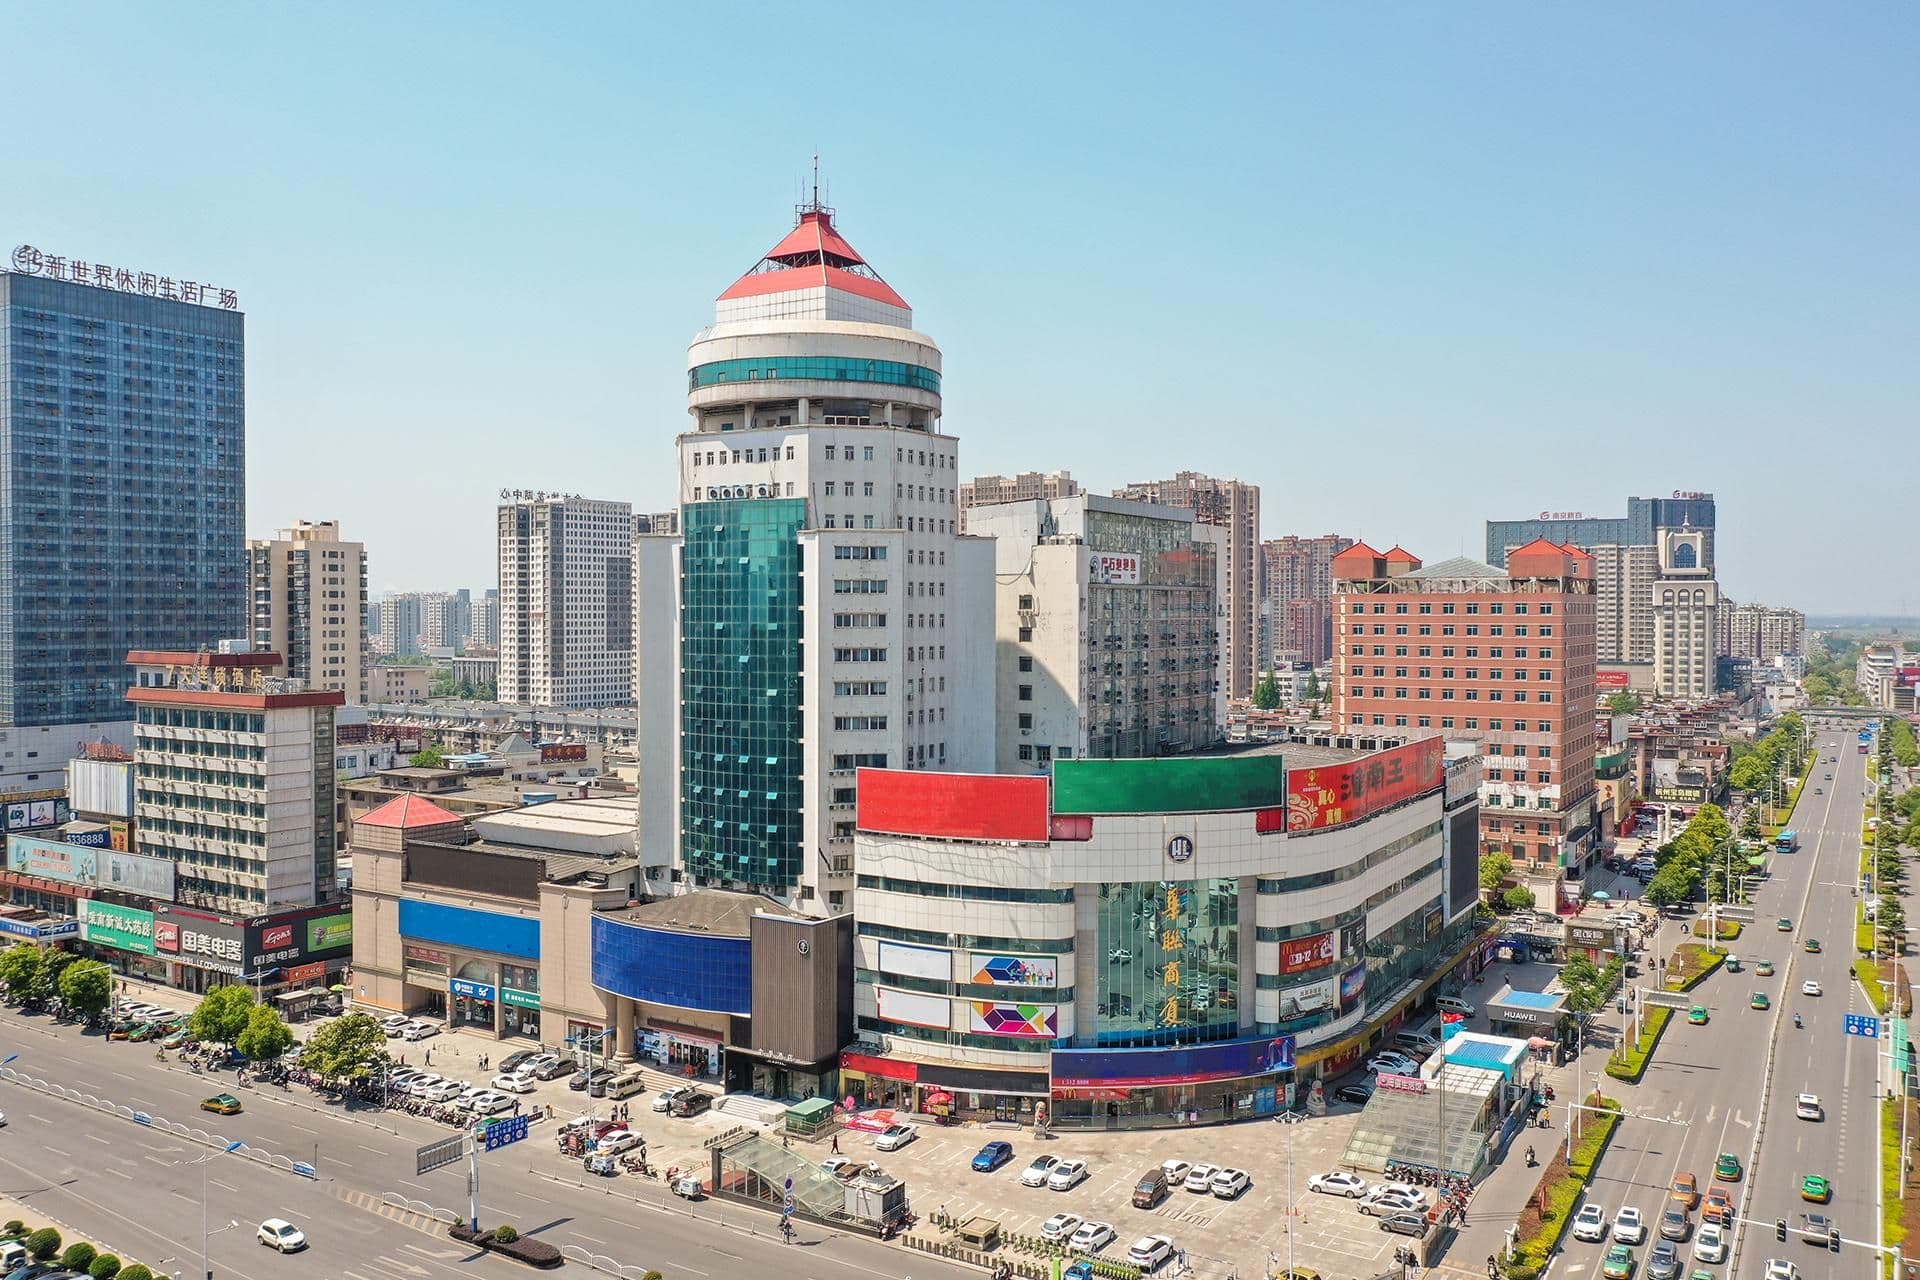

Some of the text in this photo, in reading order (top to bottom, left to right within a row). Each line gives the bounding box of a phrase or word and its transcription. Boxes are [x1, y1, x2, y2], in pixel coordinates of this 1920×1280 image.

[44, 254, 238, 310] 新世界休闲生活广场
[182, 930, 242, 961] 国美电器
[253, 947, 300, 966] 国美电器
[1503, 1010, 1537, 1021] HUAWEI
